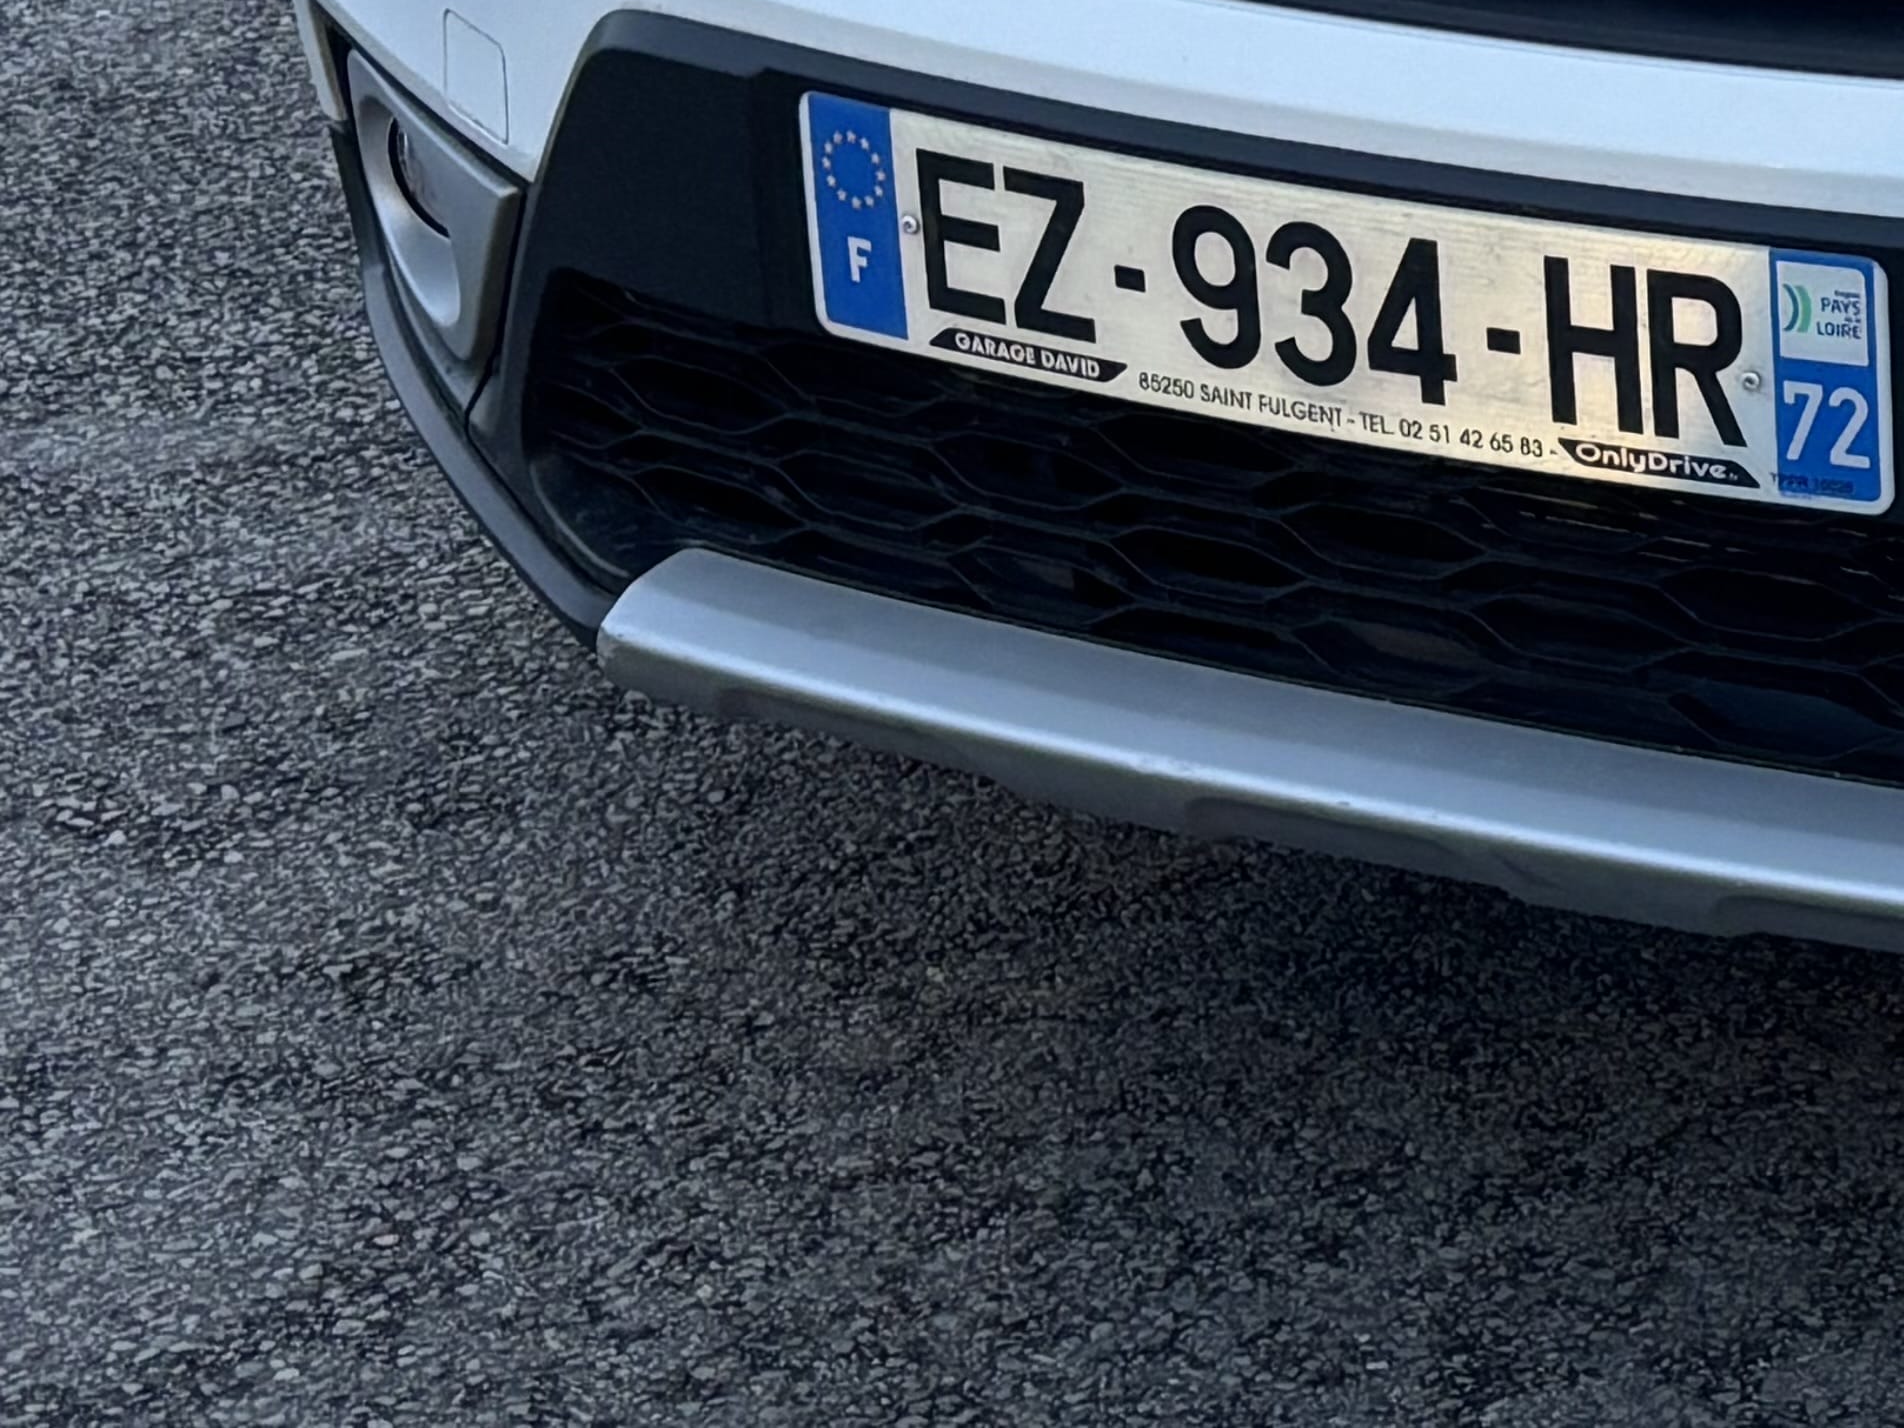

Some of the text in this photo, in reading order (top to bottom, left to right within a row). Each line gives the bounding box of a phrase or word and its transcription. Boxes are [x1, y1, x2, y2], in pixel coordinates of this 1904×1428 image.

[847, 235, 872, 284] F
[1820, 297, 1861, 316] PAYS
[1816, 321, 1862, 340] LOIRE
[955, 332, 1100, 378] GARAGE DAVID
[1139, 372, 1194, 399] 85250
[1200, 383, 1252, 410] SAINT
[1258, 393, 1342, 427] FULGENT
[1399, 418, 1423, 440] 02
[1428, 424, 1450, 444] 51
[1459, 428, 1484, 449] 42
[1490, 432, 1514, 453] 65
[1520, 437, 1543, 458] 83
[1783, 379, 1871, 469] 72
